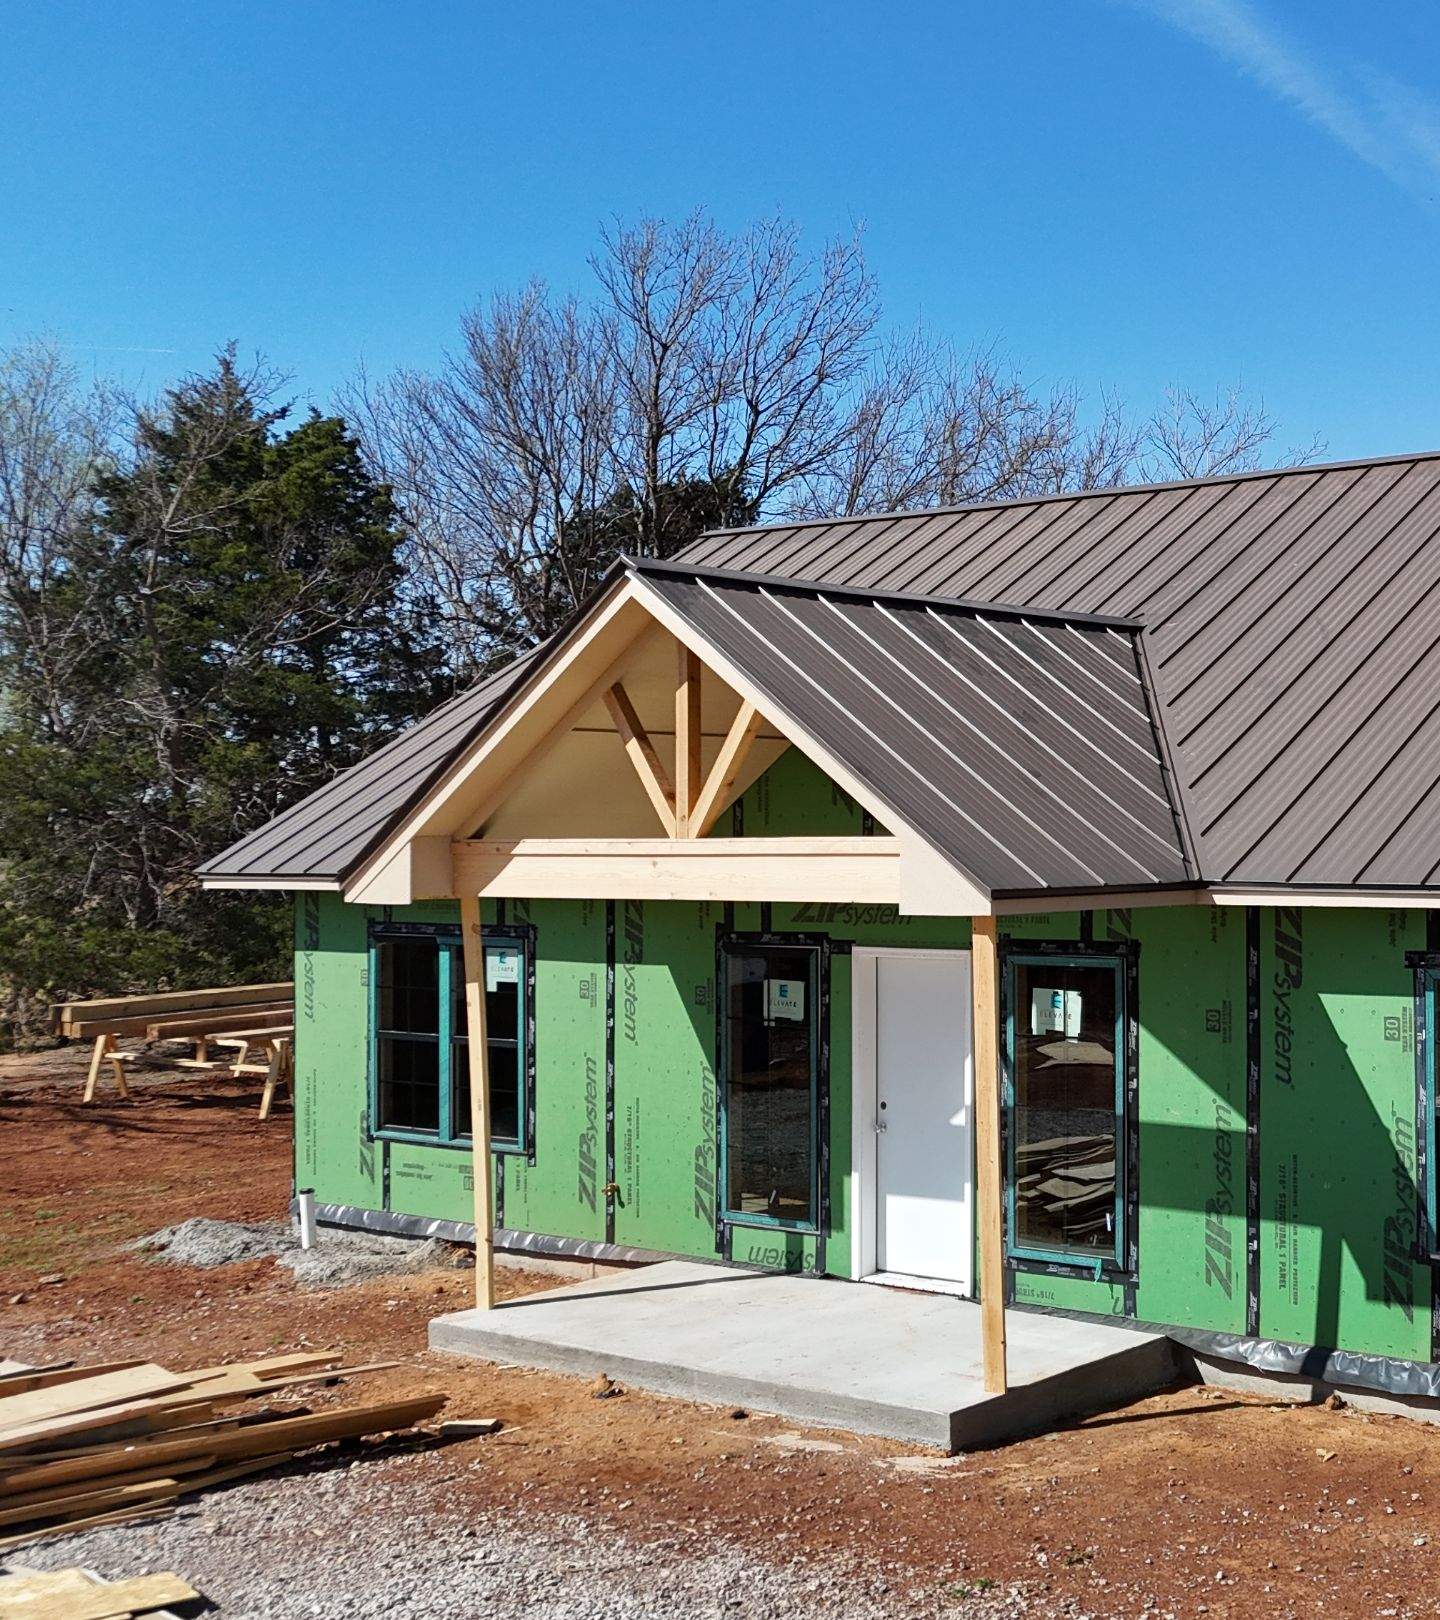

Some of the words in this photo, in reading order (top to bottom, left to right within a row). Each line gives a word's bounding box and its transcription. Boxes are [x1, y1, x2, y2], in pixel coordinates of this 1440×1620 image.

[1386, 1019, 1398, 1039] 30
[578, 1057, 597, 1215] ZIPsystem
[695, 1064, 714, 1230] ZIPsystem
[1205, 1102, 1233, 1301] ZIPsystem
[748, 1245, 815, 1272] system
[1278, 1261, 1286, 1290] PANEL
[1383, 1115, 1415, 1323] ZIPsystem
